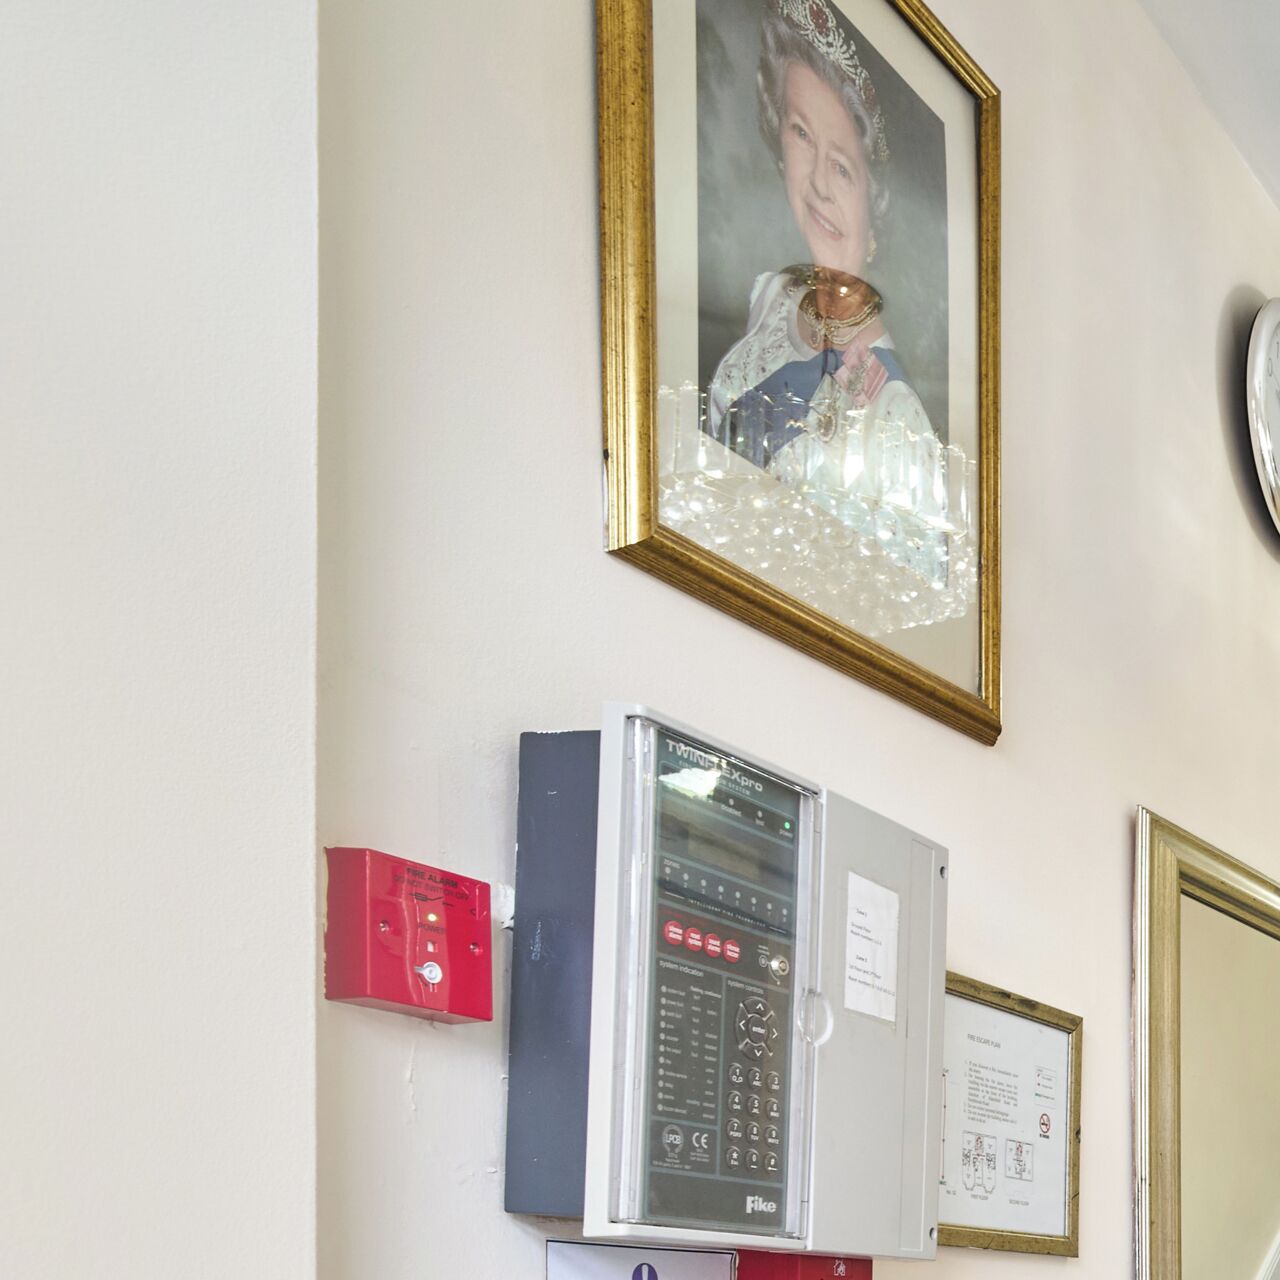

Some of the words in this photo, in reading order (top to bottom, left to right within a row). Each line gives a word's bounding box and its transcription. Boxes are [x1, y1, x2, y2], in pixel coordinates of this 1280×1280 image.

[666, 739, 763, 792] TWINFEXpro
[692, 1132, 709, 1148] CE
[746, 1196, 776, 1214] Fike
